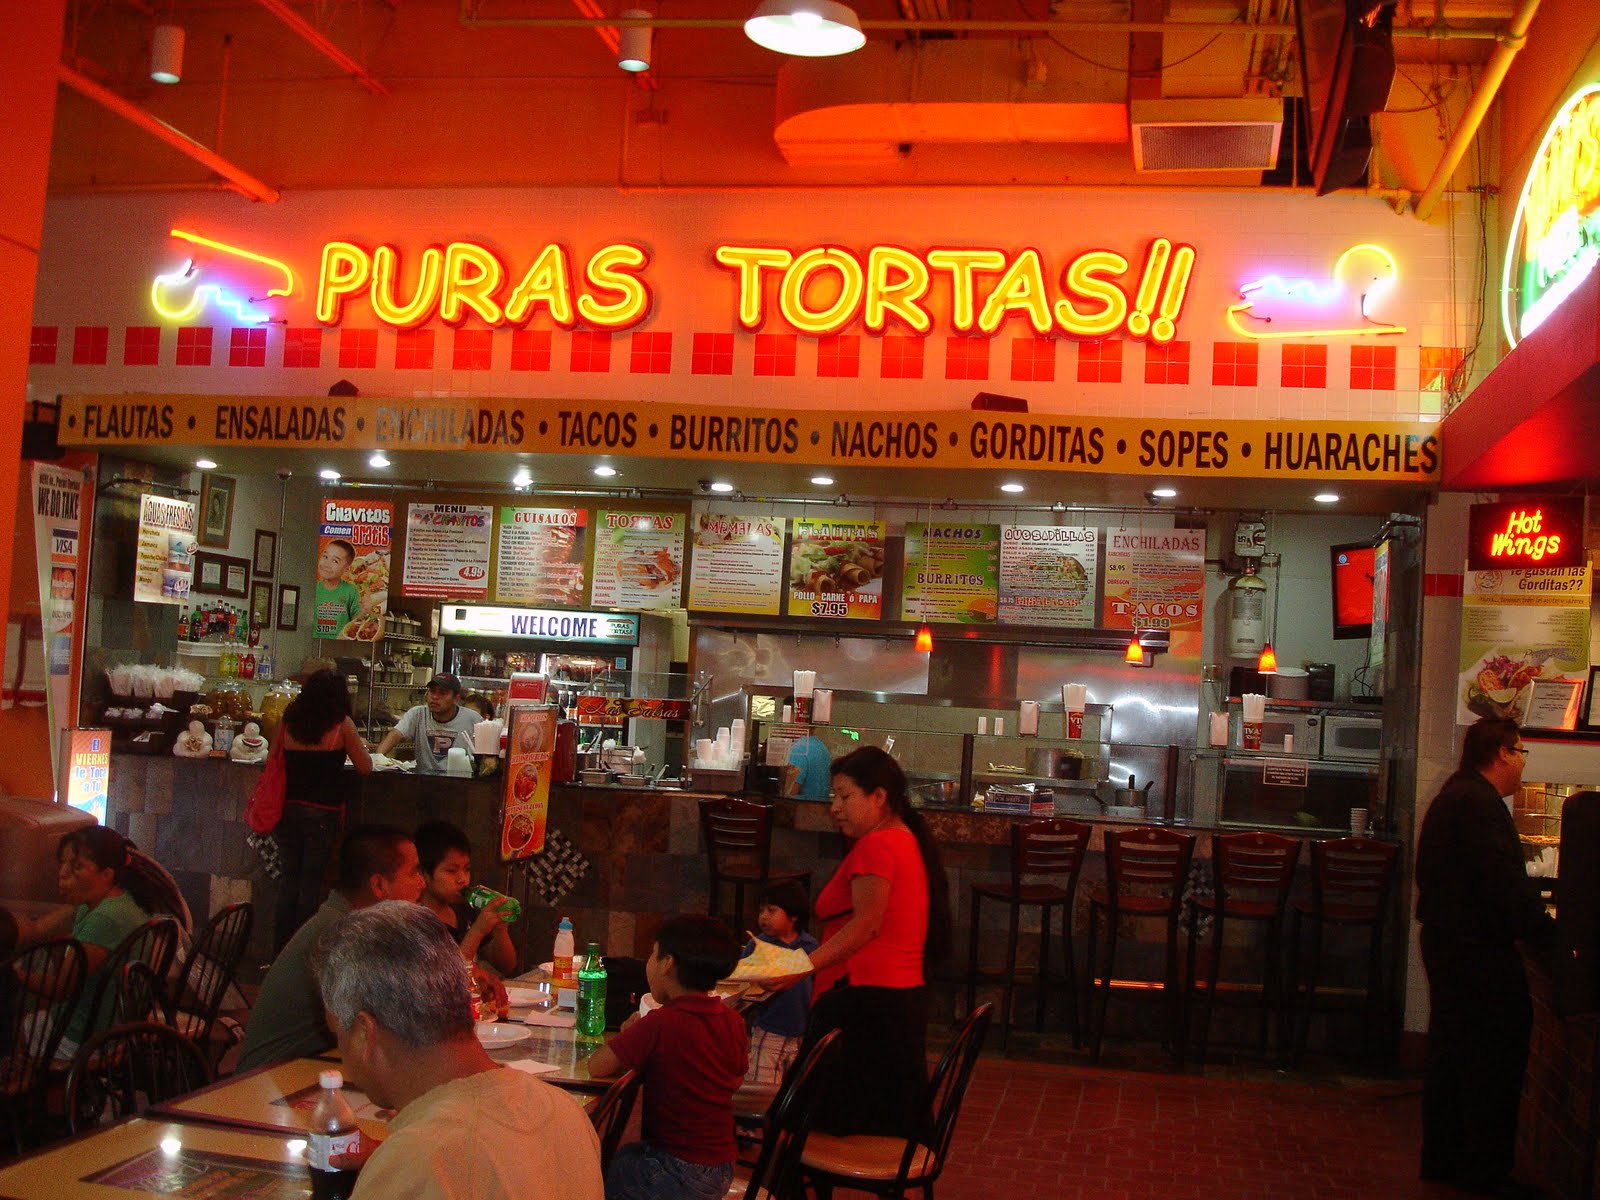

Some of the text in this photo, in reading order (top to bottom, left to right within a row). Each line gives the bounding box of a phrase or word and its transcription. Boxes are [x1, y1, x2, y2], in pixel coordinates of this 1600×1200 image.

[315, 237, 1197, 341] PURAS TORTAS!!
[84, 404, 1439, 475] FLAUTAS ENSALADAS ENCHILADAS TACOS BURRITOS NACHOS GORDITAS SOPES HUARACHES
[38, 487, 79, 520] WE DO TAKE
[434, 505, 467, 513] MENU
[1507, 509, 1543, 534] Hot
[324, 525, 390, 546] Comen gratis
[922, 528, 983, 539] NACHOS
[55, 538, 73, 555] VISA
[1112, 535, 1200, 551] ENCHILADAS
[1491, 532, 1561, 560] Wings
[464, 566, 484, 577] 4.99
[916, 572, 985, 586] BURRITOS
[1519, 578, 1583, 590] Gorditas??
[793, 591, 815, 601] POLLO
[821, 592, 845, 602] CARNE
[858, 594, 877, 604] PAPA
[810, 602, 848, 616] $7.95
[1111, 602, 1198, 618] TACOS
[511, 615, 597, 638] WELCOME
[1132, 617, 1171, 628] $1.99
[585, 700, 679, 718] Las Salsas
[75, 753, 109, 766] VIERNES
